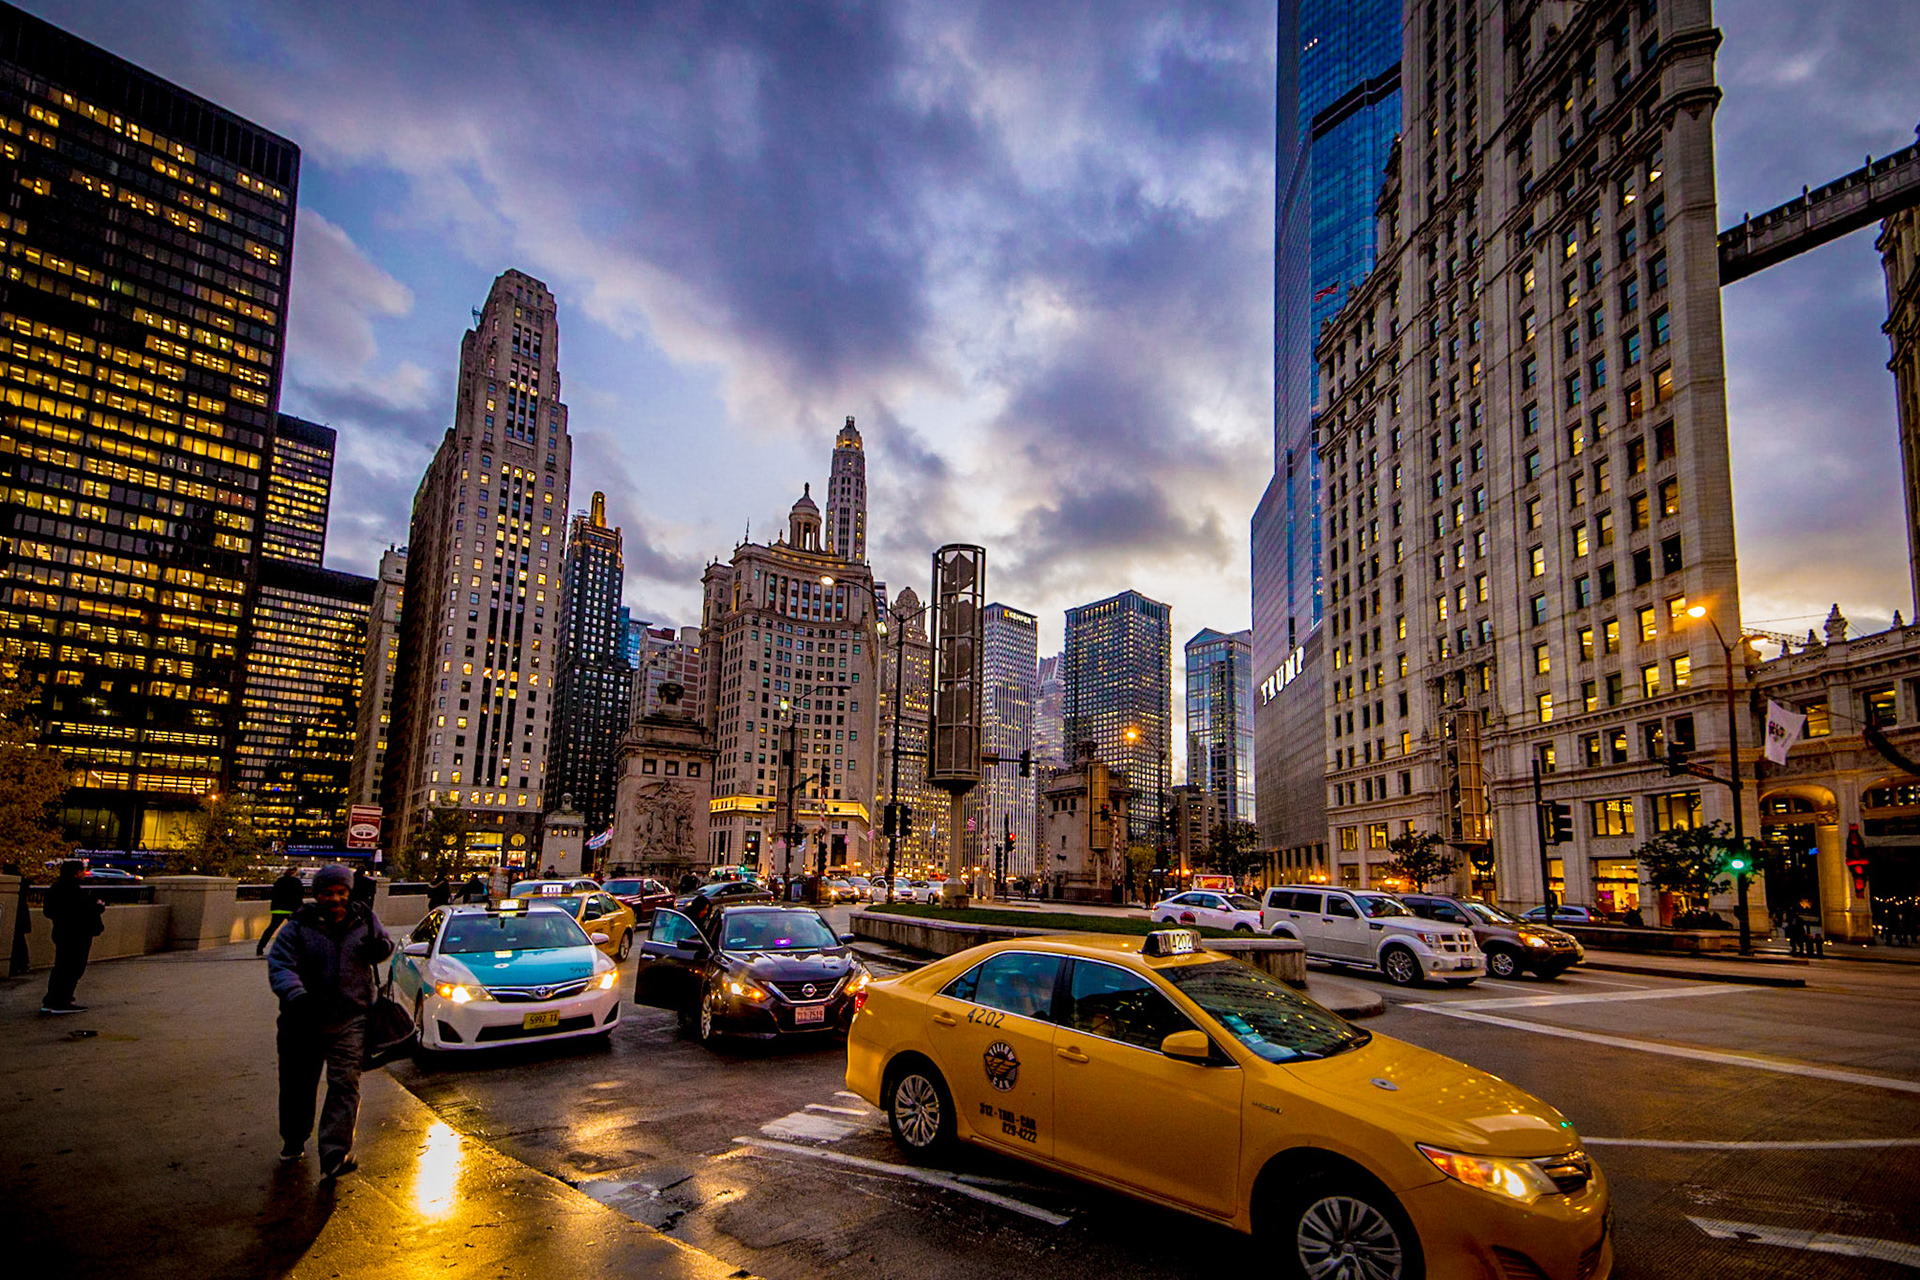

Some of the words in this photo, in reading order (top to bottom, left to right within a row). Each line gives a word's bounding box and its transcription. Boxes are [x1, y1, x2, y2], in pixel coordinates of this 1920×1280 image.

[1009, 611, 1032, 625] KEMPER
[1260, 646, 1305, 706] TRUMP
[1172, 933, 1192, 950] 4202
[529, 1014, 547, 1025] 5992
[967, 1008, 1005, 1029] 4202
[988, 1043, 1015, 1061] YELLOW
[979, 1102, 994, 1117] 312
[998, 1107, 1015, 1124] TAXI
[1020, 1115, 1037, 1131] CAB
[1002, 1121, 1038, 1144] 829-4222
